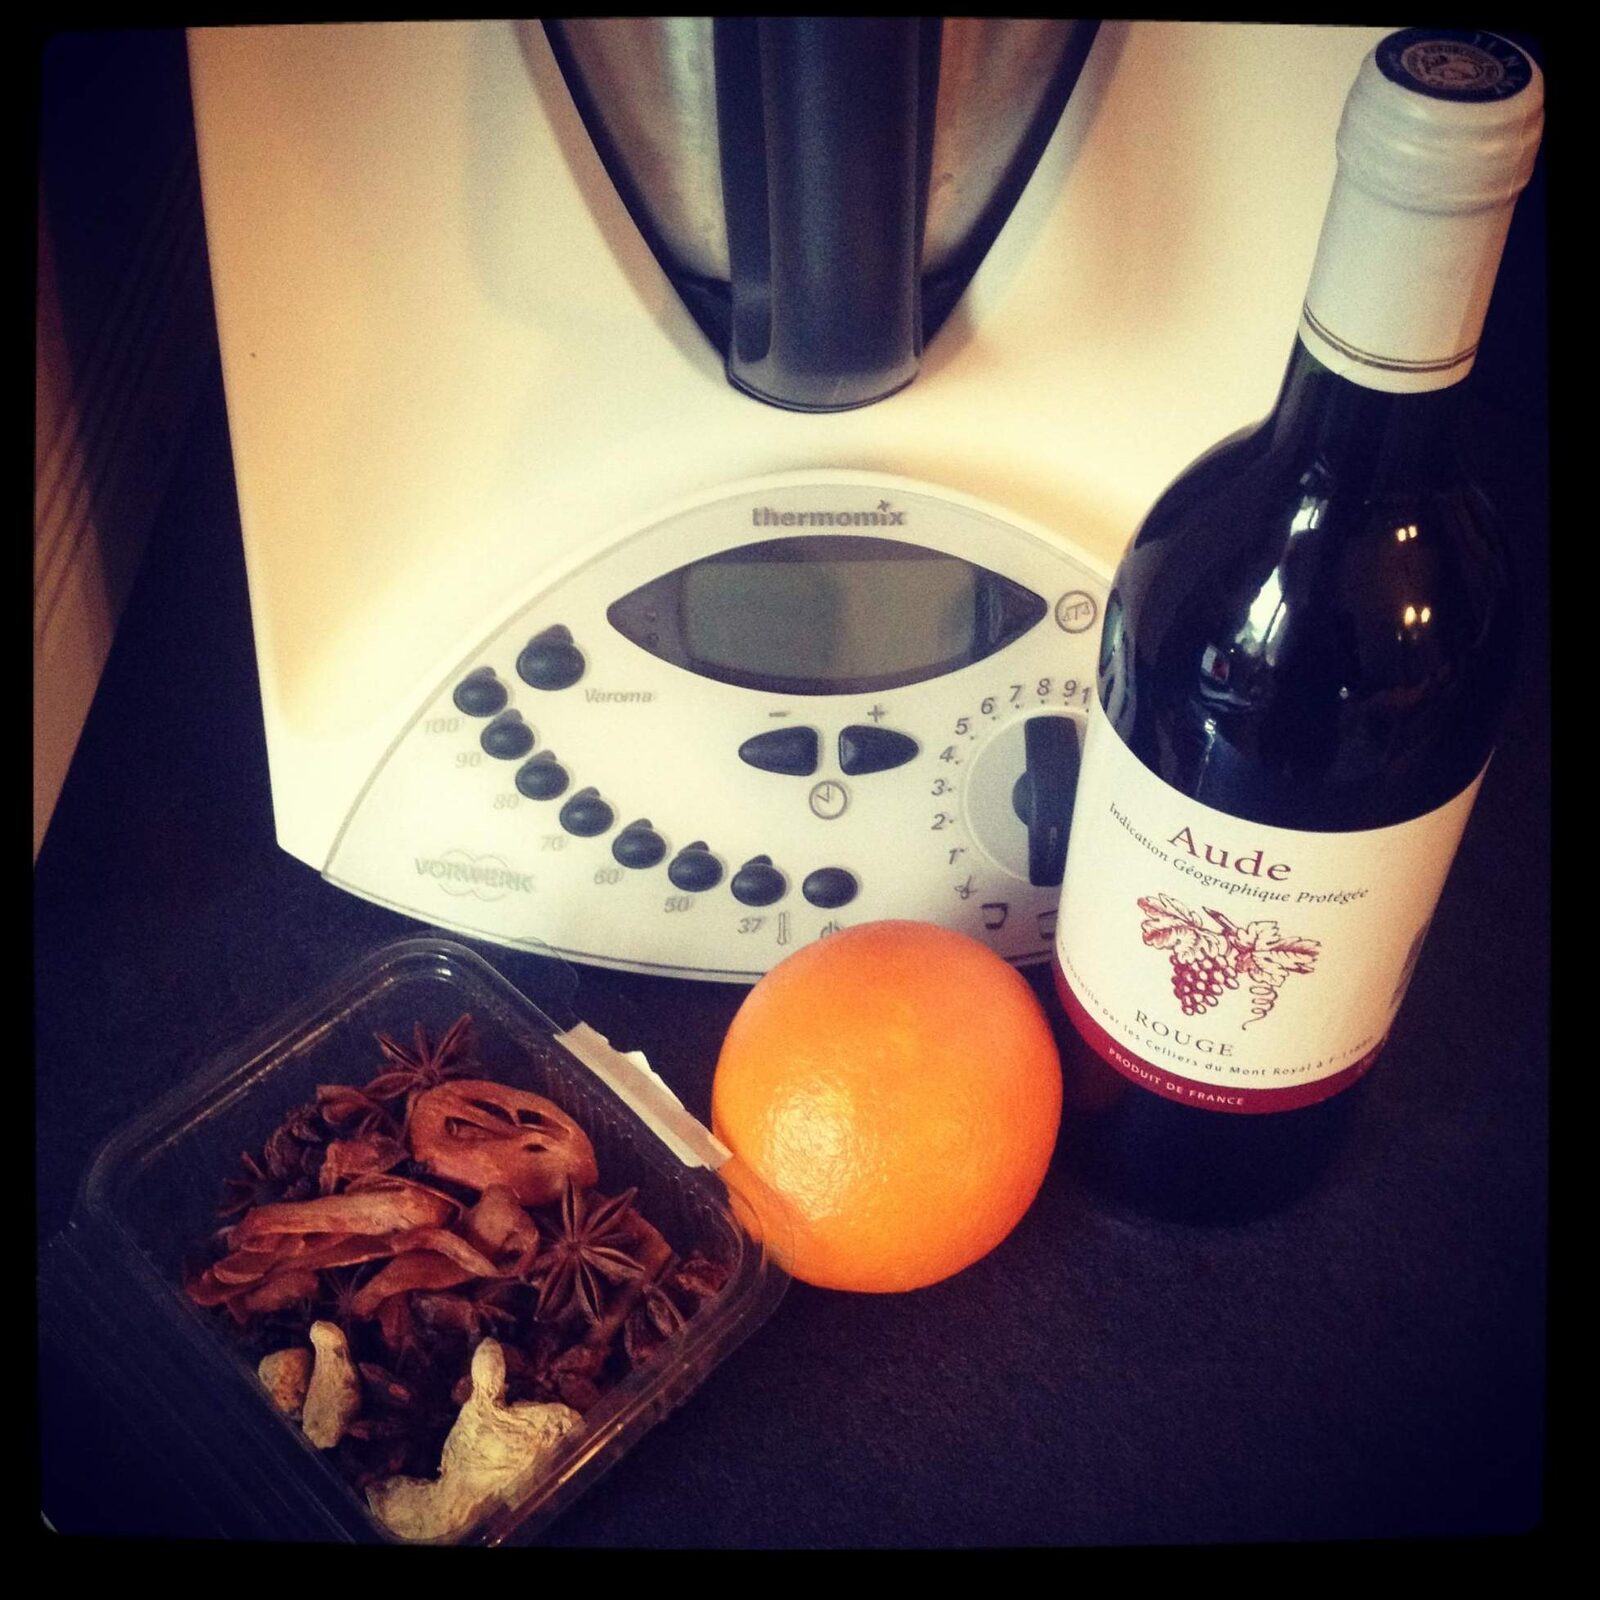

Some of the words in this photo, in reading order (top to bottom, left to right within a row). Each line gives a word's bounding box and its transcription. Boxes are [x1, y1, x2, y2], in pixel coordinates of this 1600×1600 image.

[752, 500, 906, 527] thermomix
[585, 688, 655, 703] Varoma
[1009, 684, 1022, 703] 7
[1036, 678, 1050, 697] 8
[1063, 679, 1078, 698] 9
[980, 696, 995, 715] 6
[423, 718, 461, 735] 100
[955, 717, 970, 736] 5
[455, 751, 482, 768] 90
[939, 745, 955, 764] 4
[931, 778, 945, 797] 3
[493, 793, 520, 810] 80
[930, 813, 946, 831] 2
[1109, 802, 1169, 862] Indication
[1172, 858, 1290, 903] Géographique
[1296, 888, 1369, 905] Protégée
[1167, 826, 1292, 882] Aude
[414, 857, 535, 894] VORWERK
[593, 868, 621, 886] 60
[663, 897, 692, 914] 50
[737, 917, 763, 935] 37
[1135, 1009, 1235, 1057] ROUGE
[1124, 1024, 1140, 1041] les
[1145, 1039, 1198, 1066] Celliers
[1205, 1062, 1222, 1072] du
[1229, 1066, 1266, 1076] Mont
[1273, 1063, 1311, 1076] Royal
[1108, 1047, 1161, 1085] PRODUIT
[1166, 1082, 1184, 1094] DE
[1188, 1089, 1244, 1106] FRANCE
